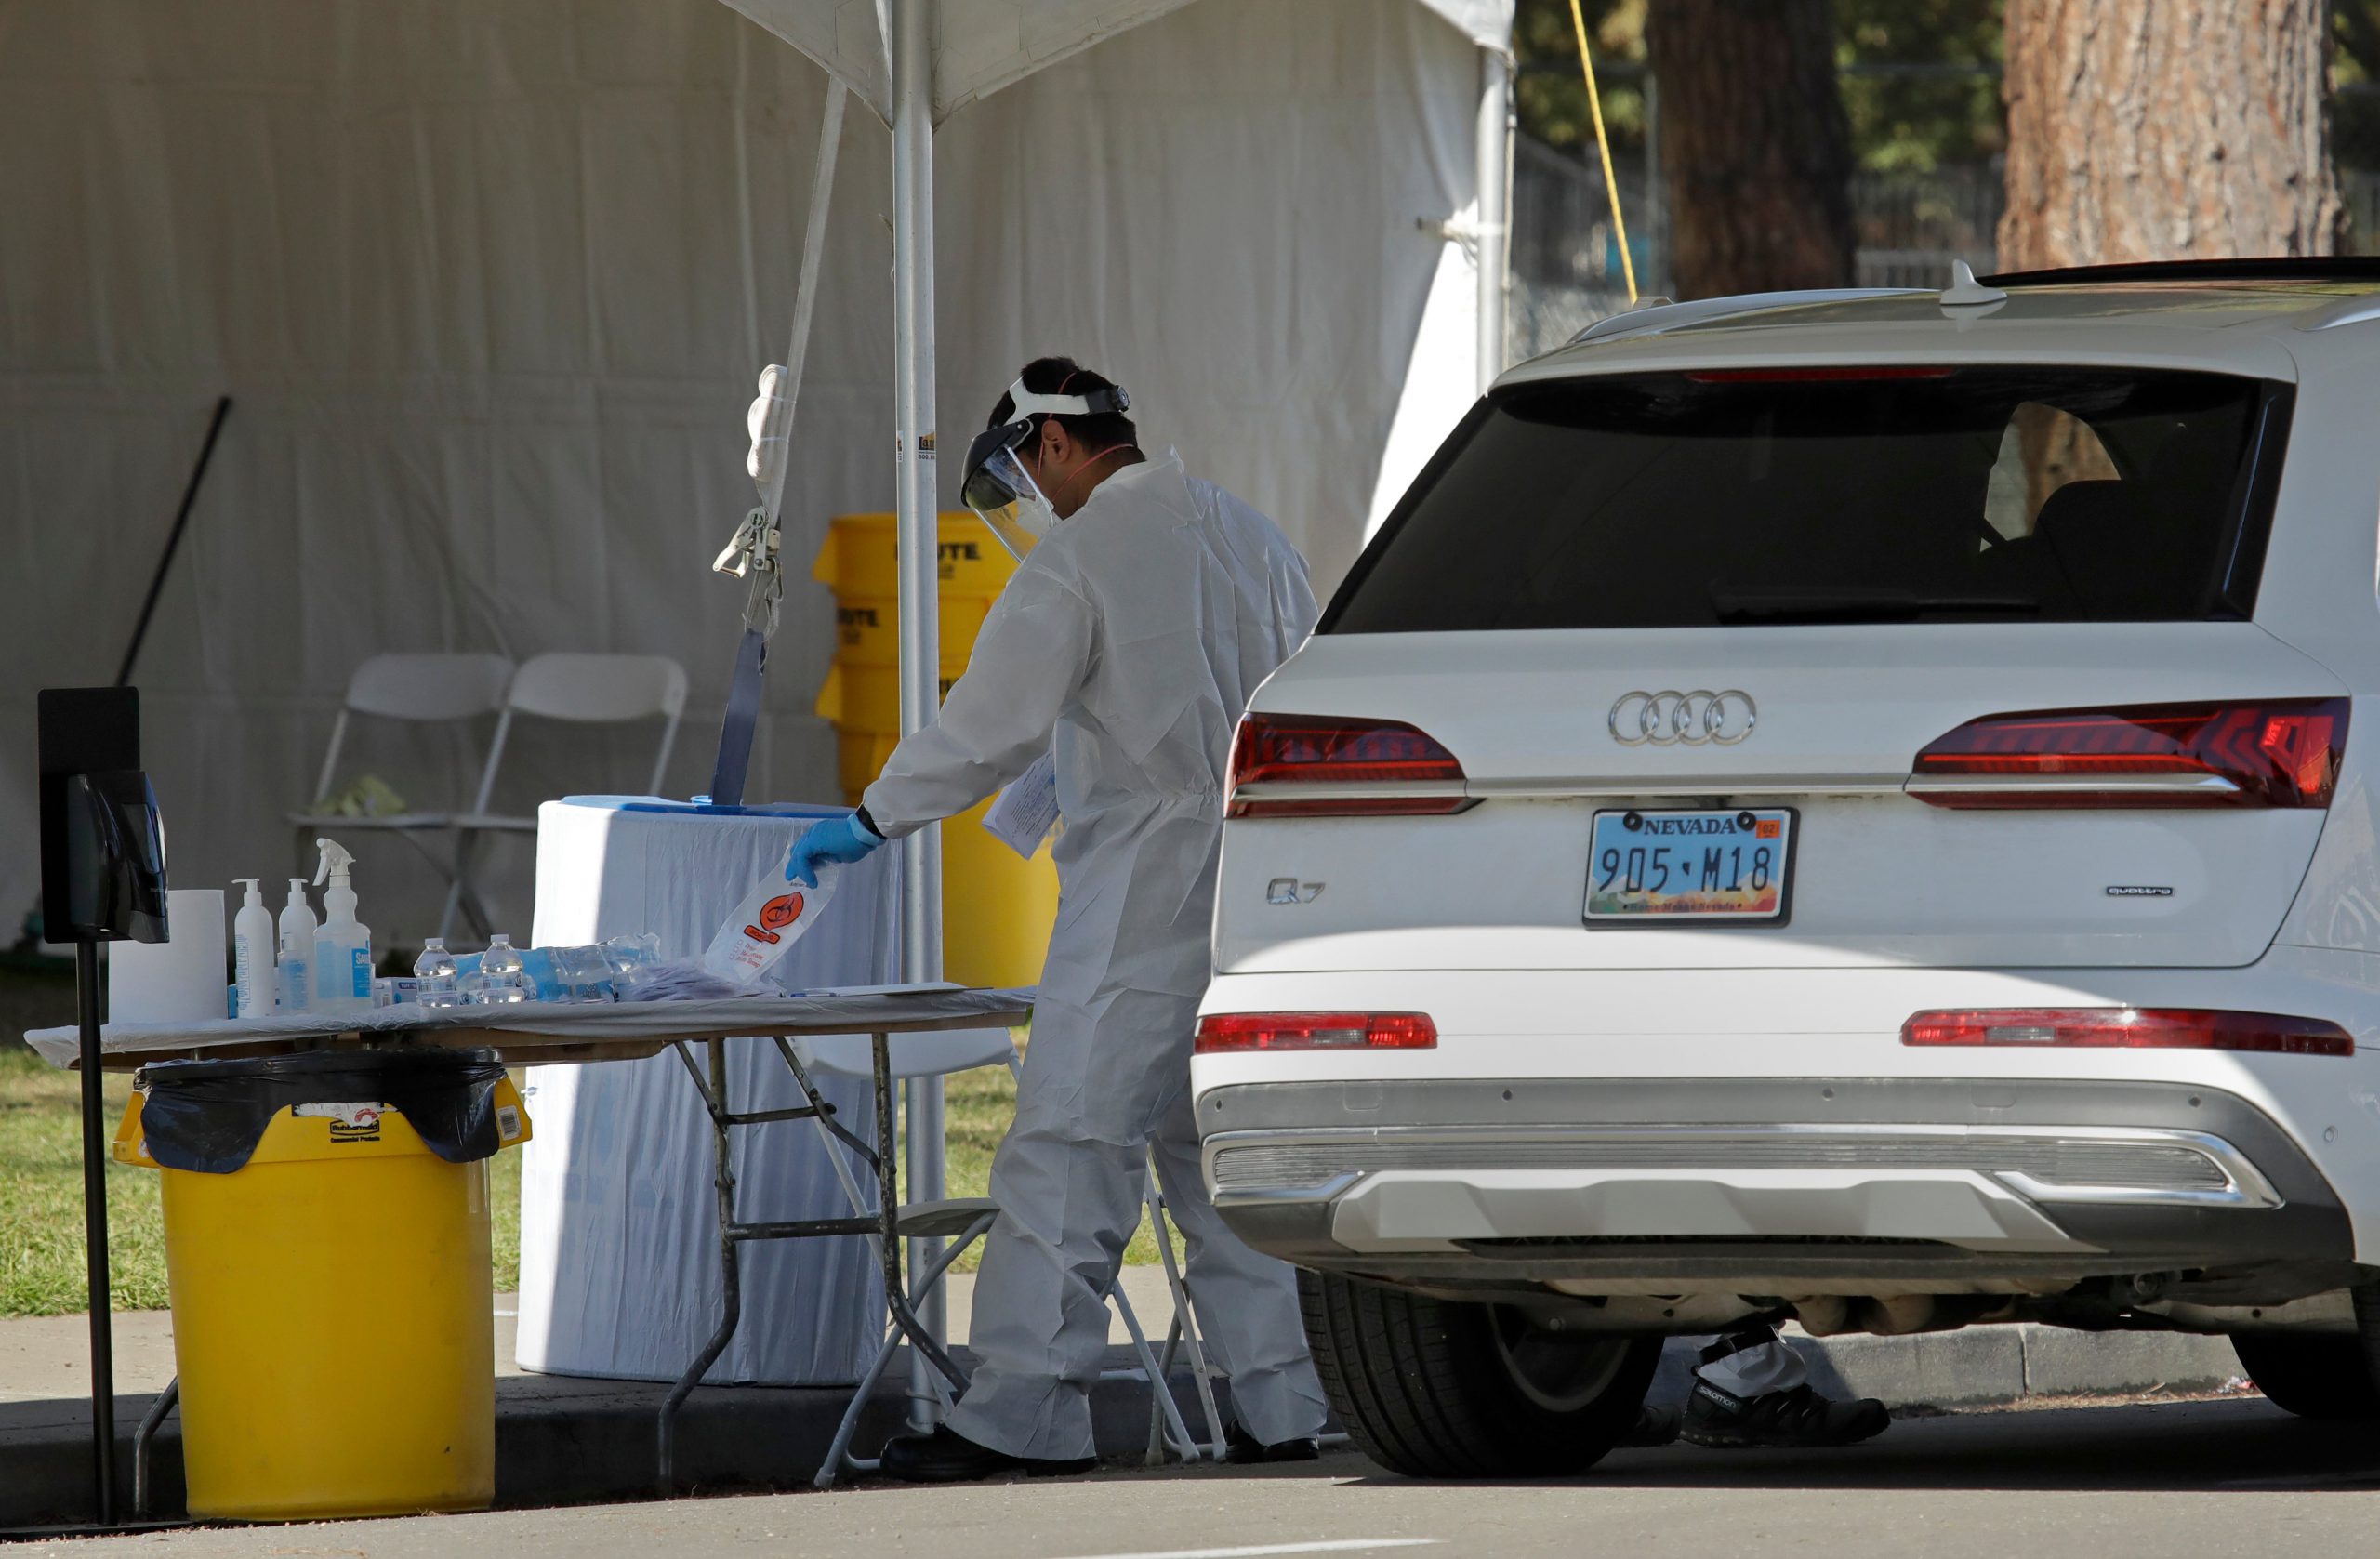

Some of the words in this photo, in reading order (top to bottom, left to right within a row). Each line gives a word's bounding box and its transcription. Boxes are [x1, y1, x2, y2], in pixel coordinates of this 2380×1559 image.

[1644, 818, 1737, 835] NEVADA
[1266, 878, 1326, 905] Q7
[2108, 887, 2172, 895] quattro
